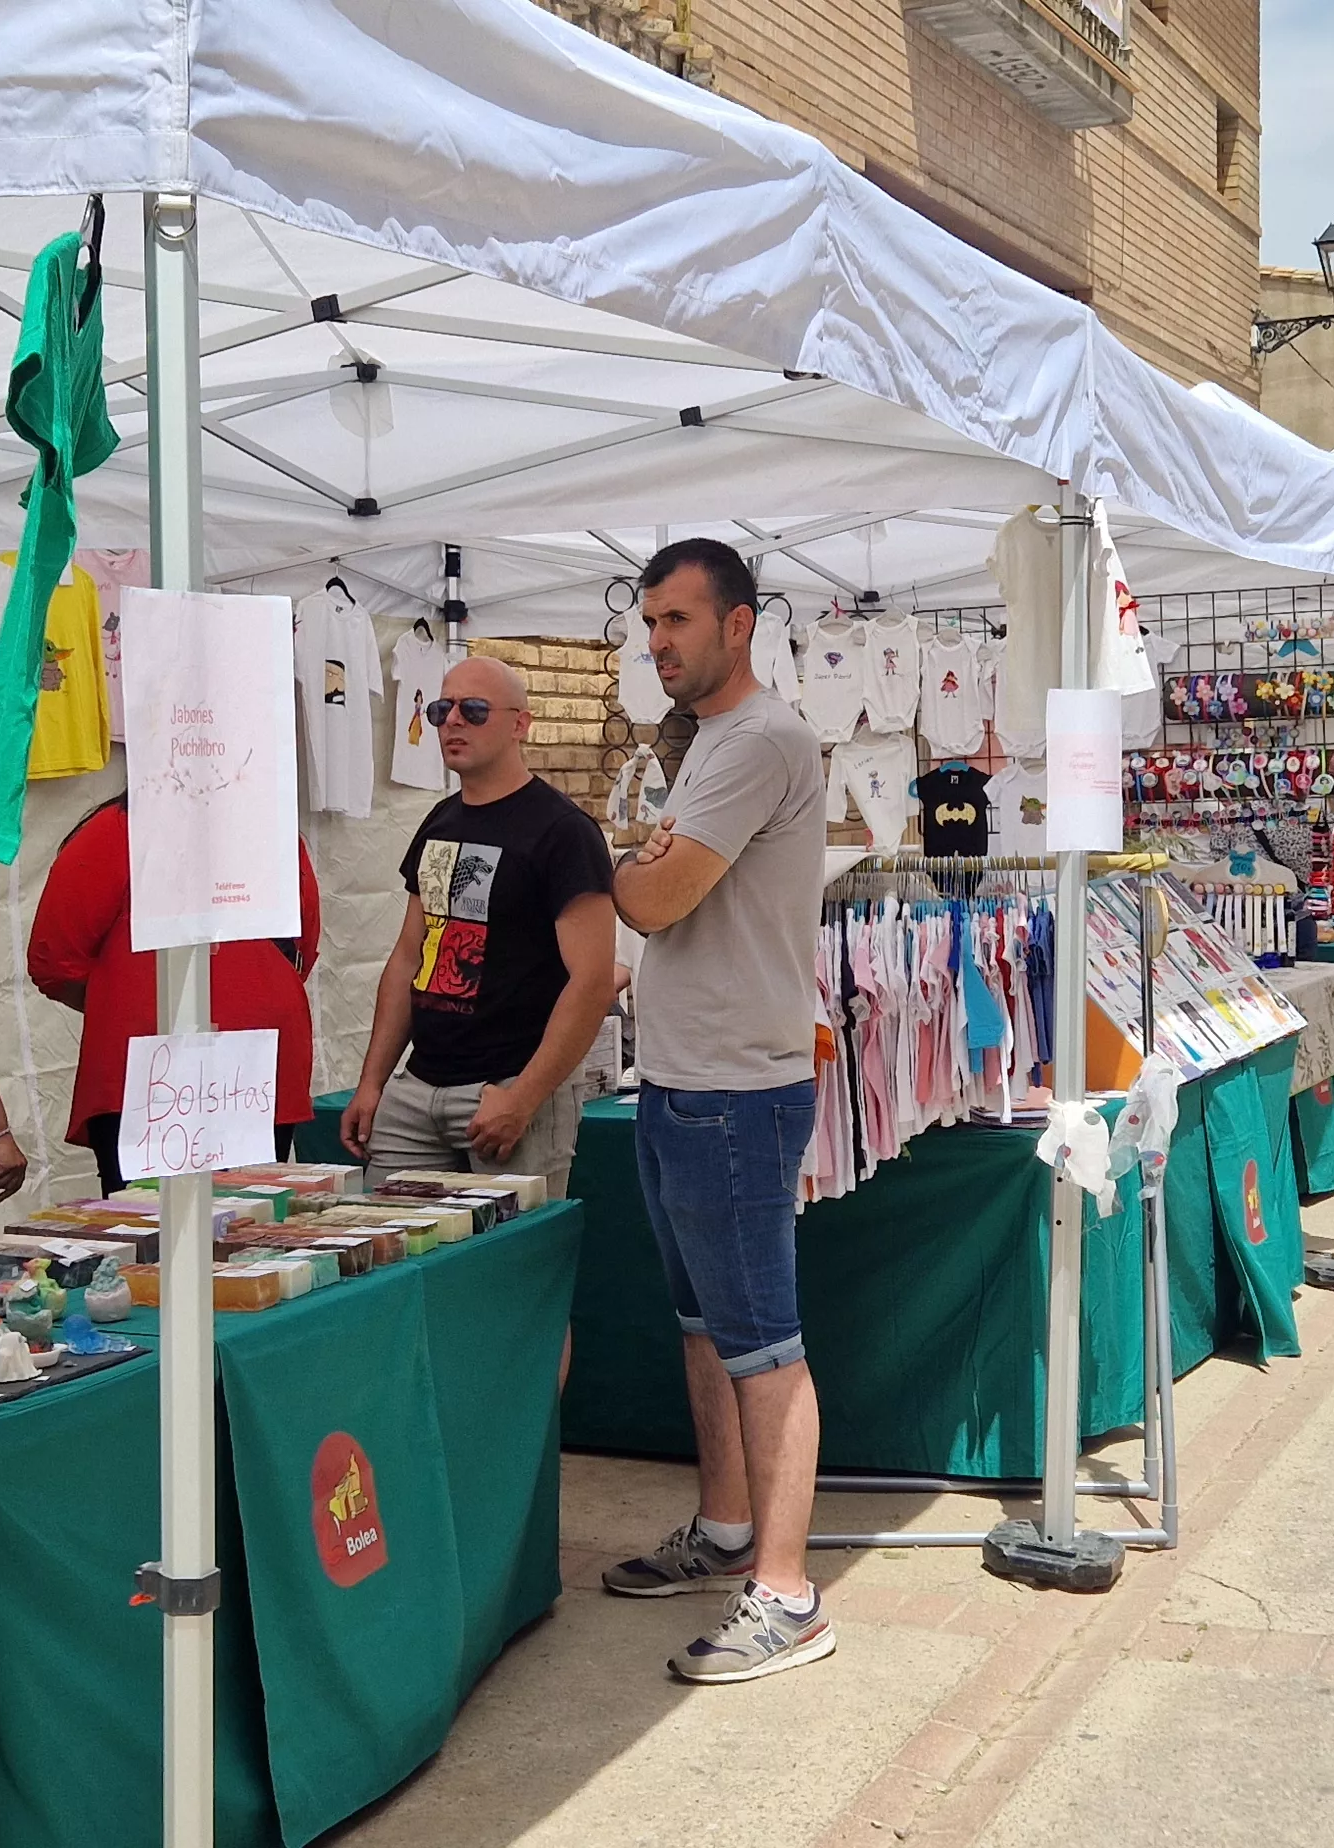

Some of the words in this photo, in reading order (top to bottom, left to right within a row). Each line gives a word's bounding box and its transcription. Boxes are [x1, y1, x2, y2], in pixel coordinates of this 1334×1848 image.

[989, 57, 1048, 84] 1992
[171, 704, 214, 725] Jabones
[148, 1043, 272, 1122] Bolsitas
[346, 1527, 378, 1557] Bolea
